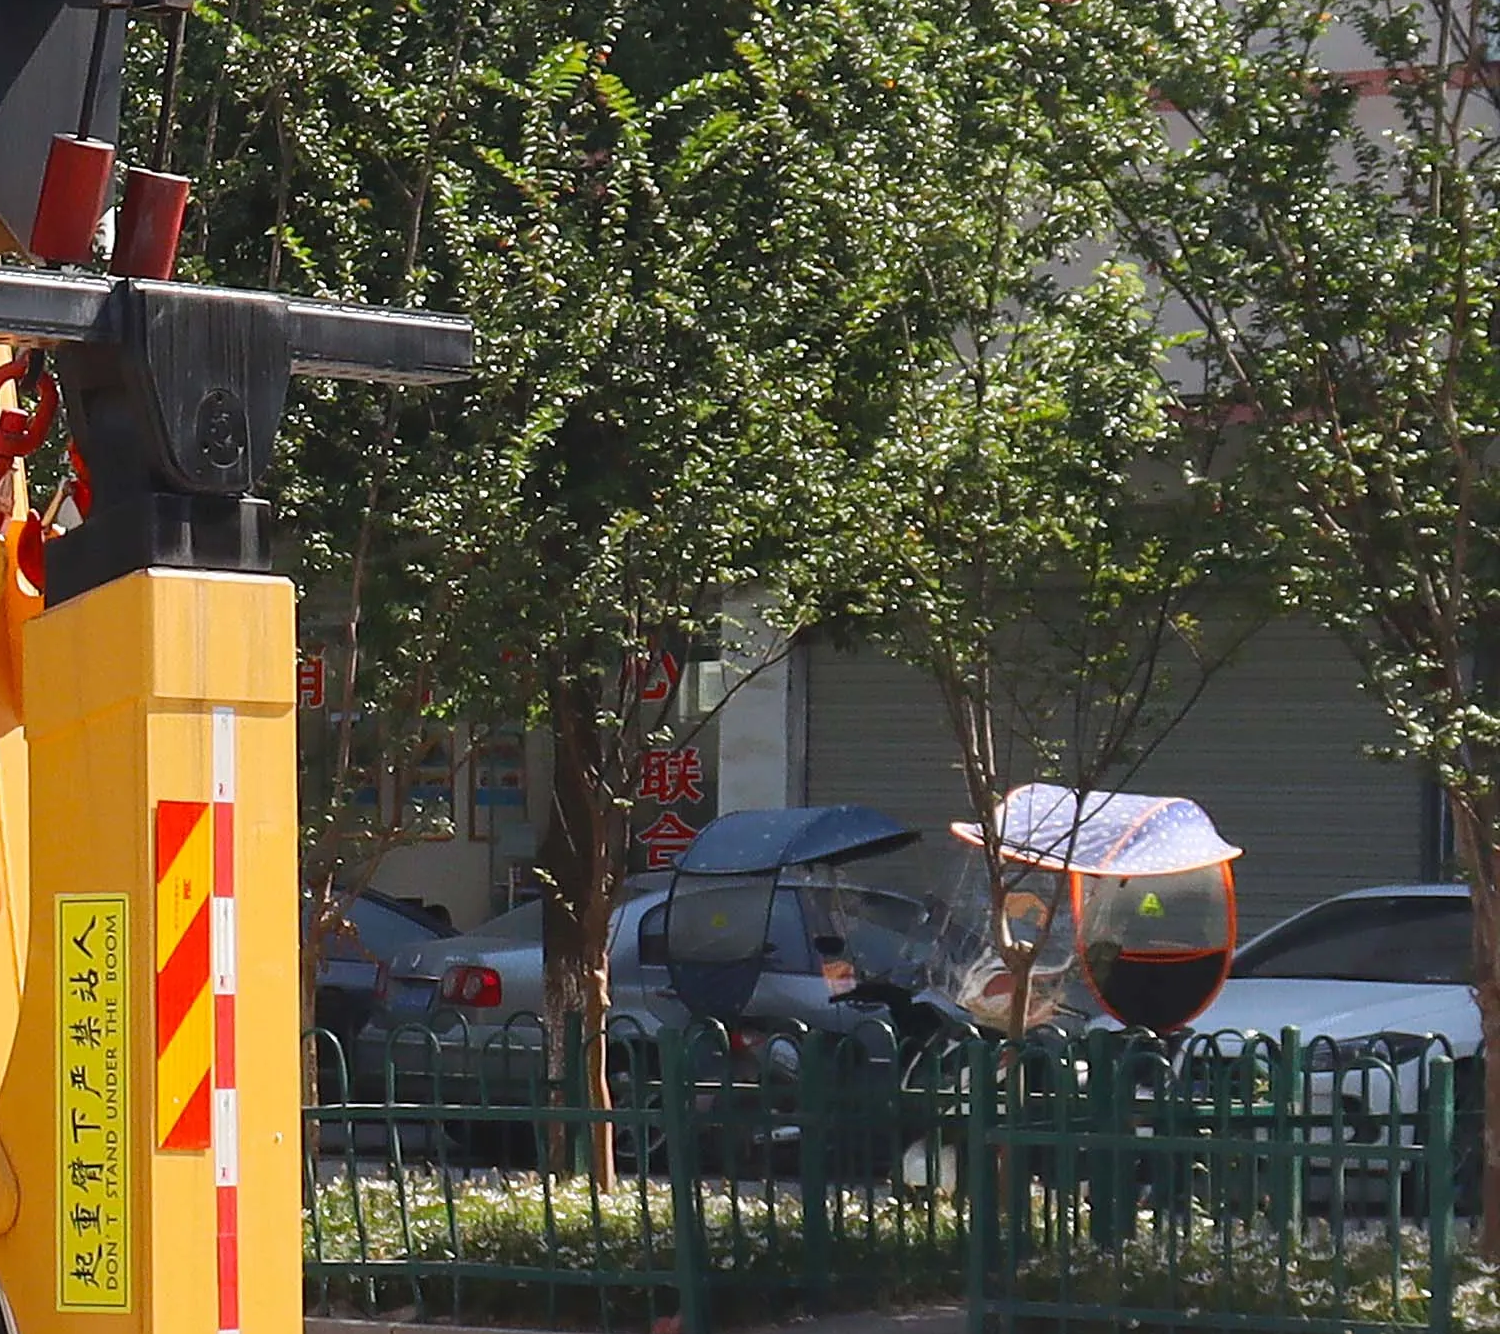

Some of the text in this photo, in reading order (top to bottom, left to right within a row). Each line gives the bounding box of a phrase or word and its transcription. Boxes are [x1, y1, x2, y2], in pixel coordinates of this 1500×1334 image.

[105, 914, 118, 982] BOOM
[105, 997, 118, 1037] THE
[67, 914, 104, 1289] 起重臂下严禁站人
[105, 1048, 118, 1120] UNDER
[106, 1130, 118, 1199] STAND
